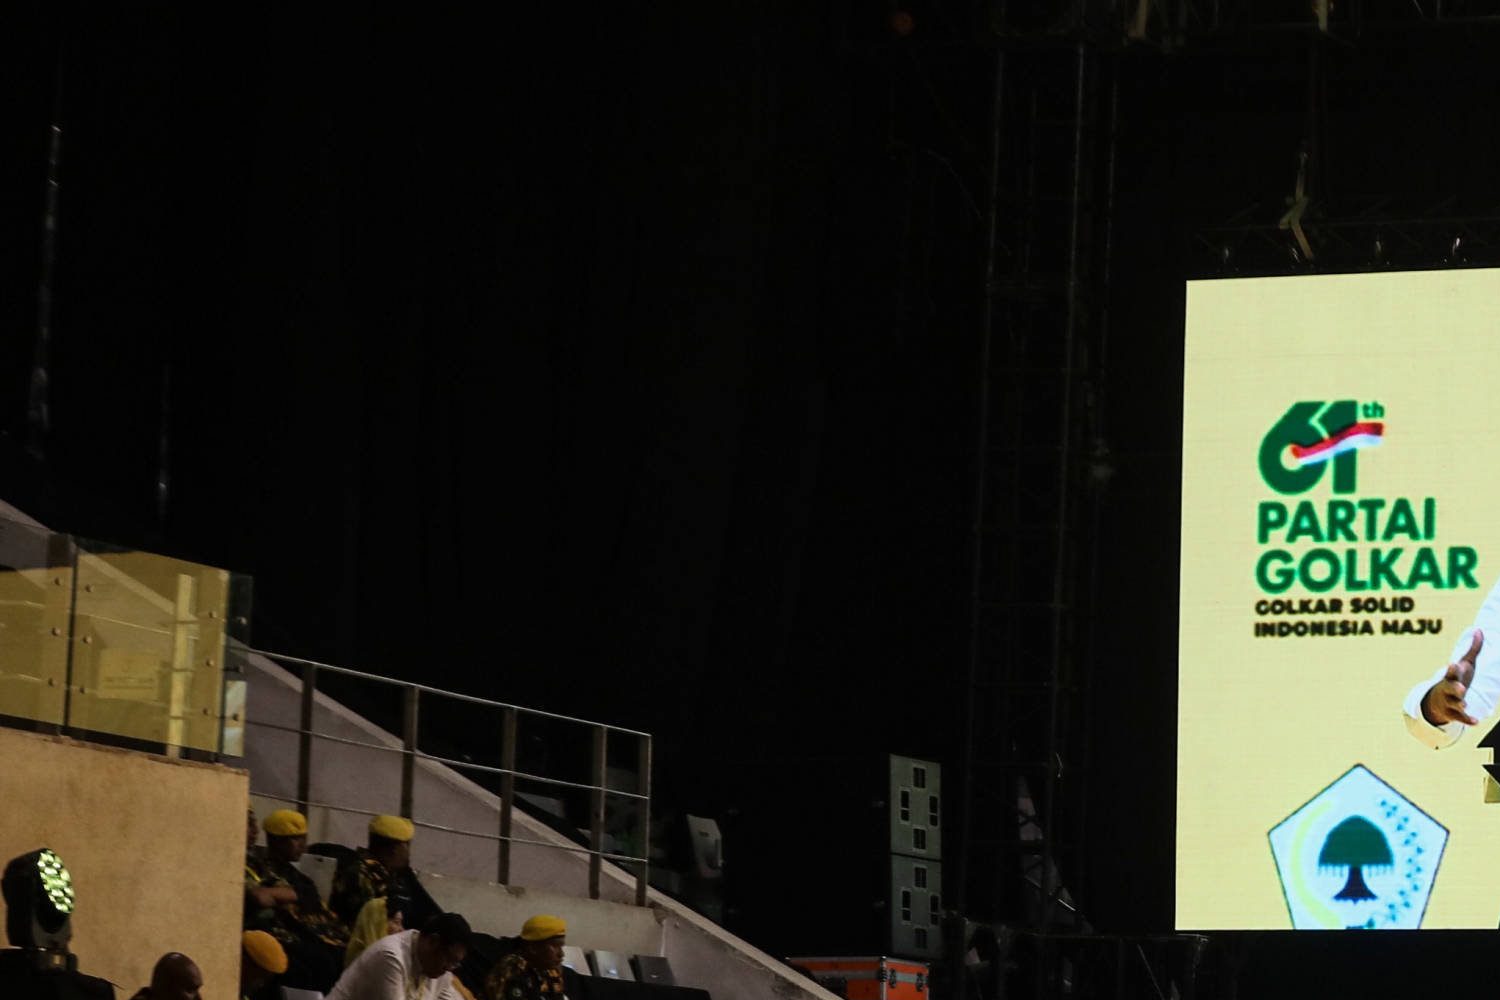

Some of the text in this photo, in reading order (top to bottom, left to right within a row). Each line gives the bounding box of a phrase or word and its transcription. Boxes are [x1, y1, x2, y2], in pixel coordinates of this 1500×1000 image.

[1257, 498, 1436, 544] PARTAI
[1255, 546, 1479, 594] GOLKAR
[1254, 597, 1415, 615] GOLKAR SOLID
[1254, 619, 1442, 638] INDONESIA MAJU
